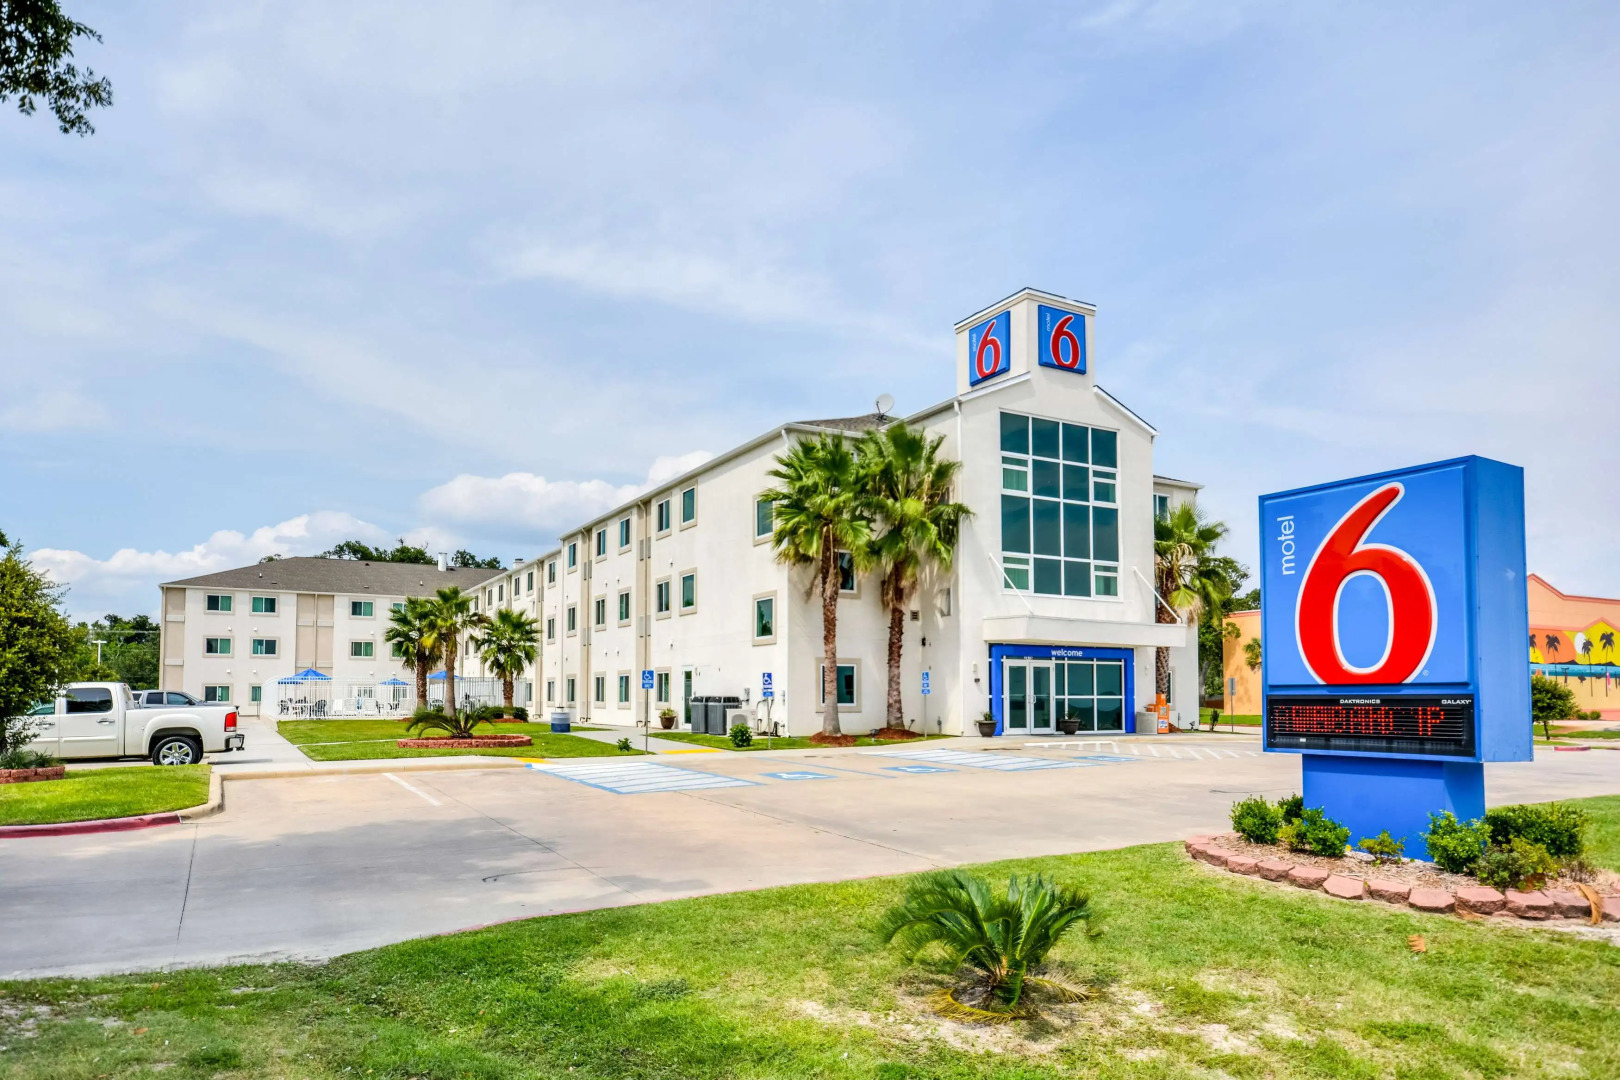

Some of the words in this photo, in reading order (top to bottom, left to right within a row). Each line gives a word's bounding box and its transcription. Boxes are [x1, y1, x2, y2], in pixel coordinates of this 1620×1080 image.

[975, 319, 1002, 379] 6
[1050, 314, 1081, 369] 6
[1276, 515, 1296, 575] motel
[1295, 481, 1438, 684] 6
[1050, 648, 1083, 657] welcome
